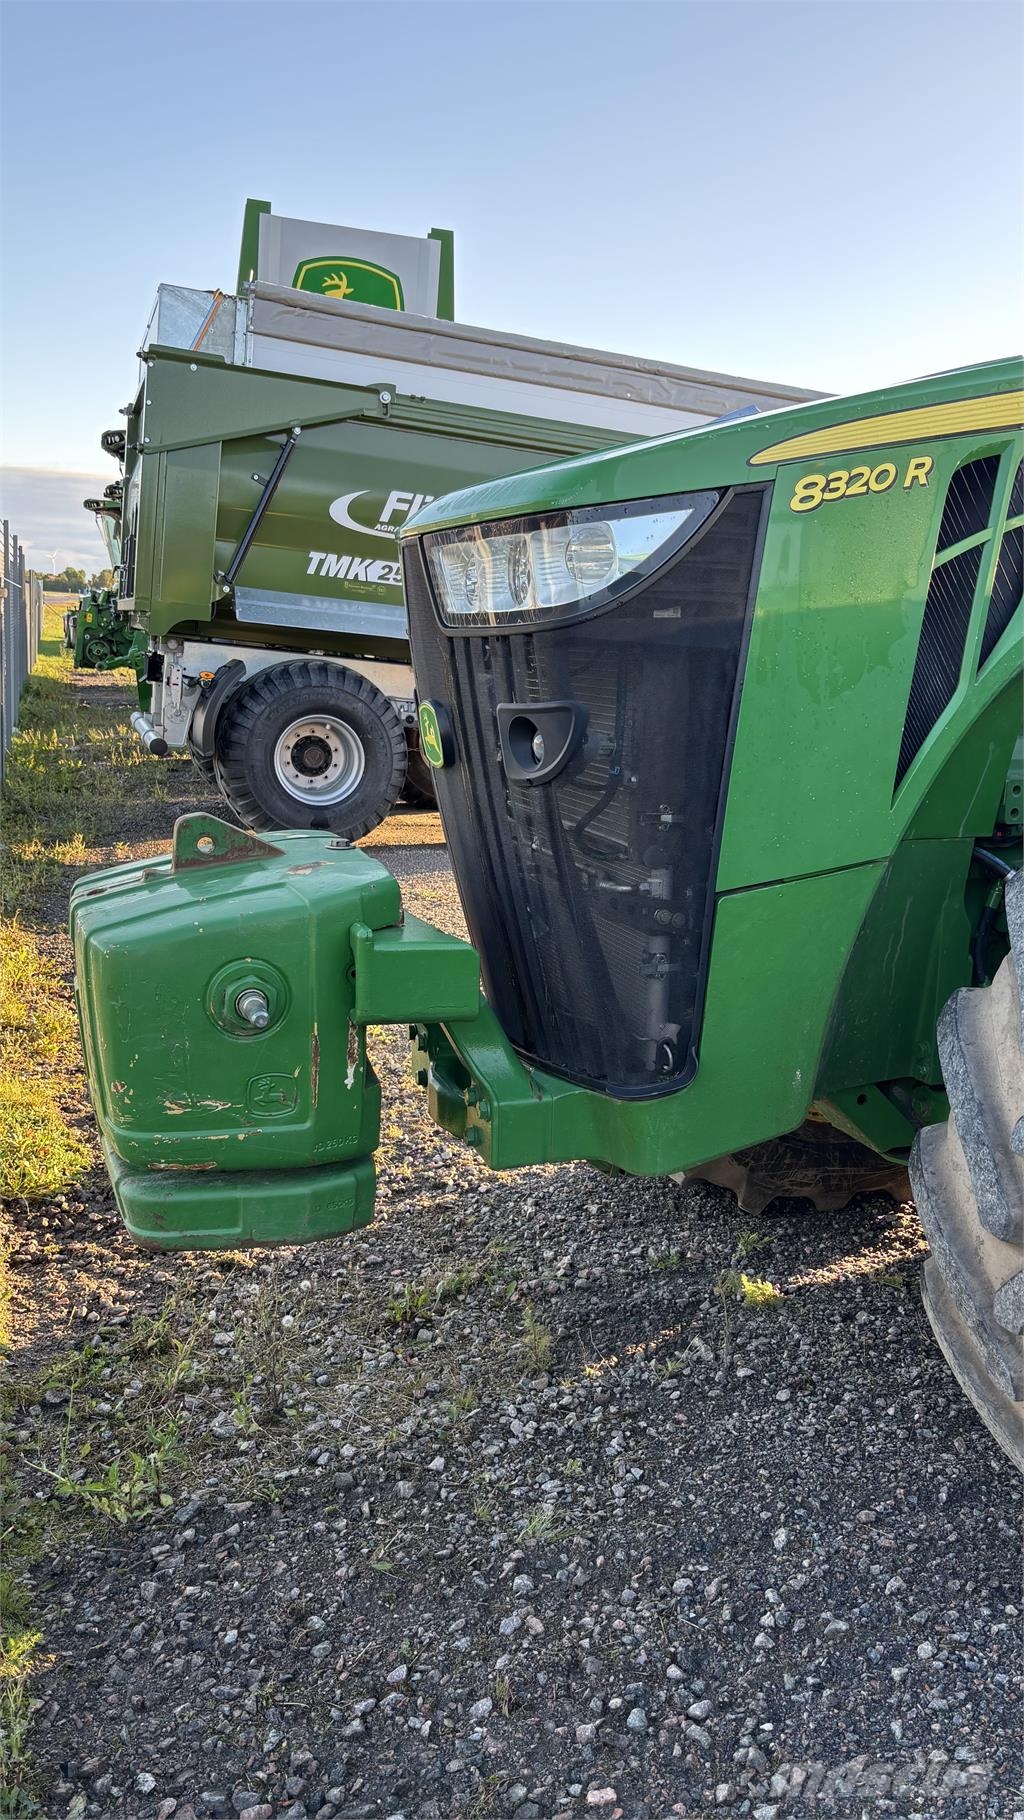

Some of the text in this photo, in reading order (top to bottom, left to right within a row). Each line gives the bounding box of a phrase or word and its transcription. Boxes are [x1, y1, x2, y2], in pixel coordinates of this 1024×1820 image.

[789, 456, 934, 514] 8320 R
[379, 490, 434, 523] Fl
[306, 551, 373, 582] TMK
